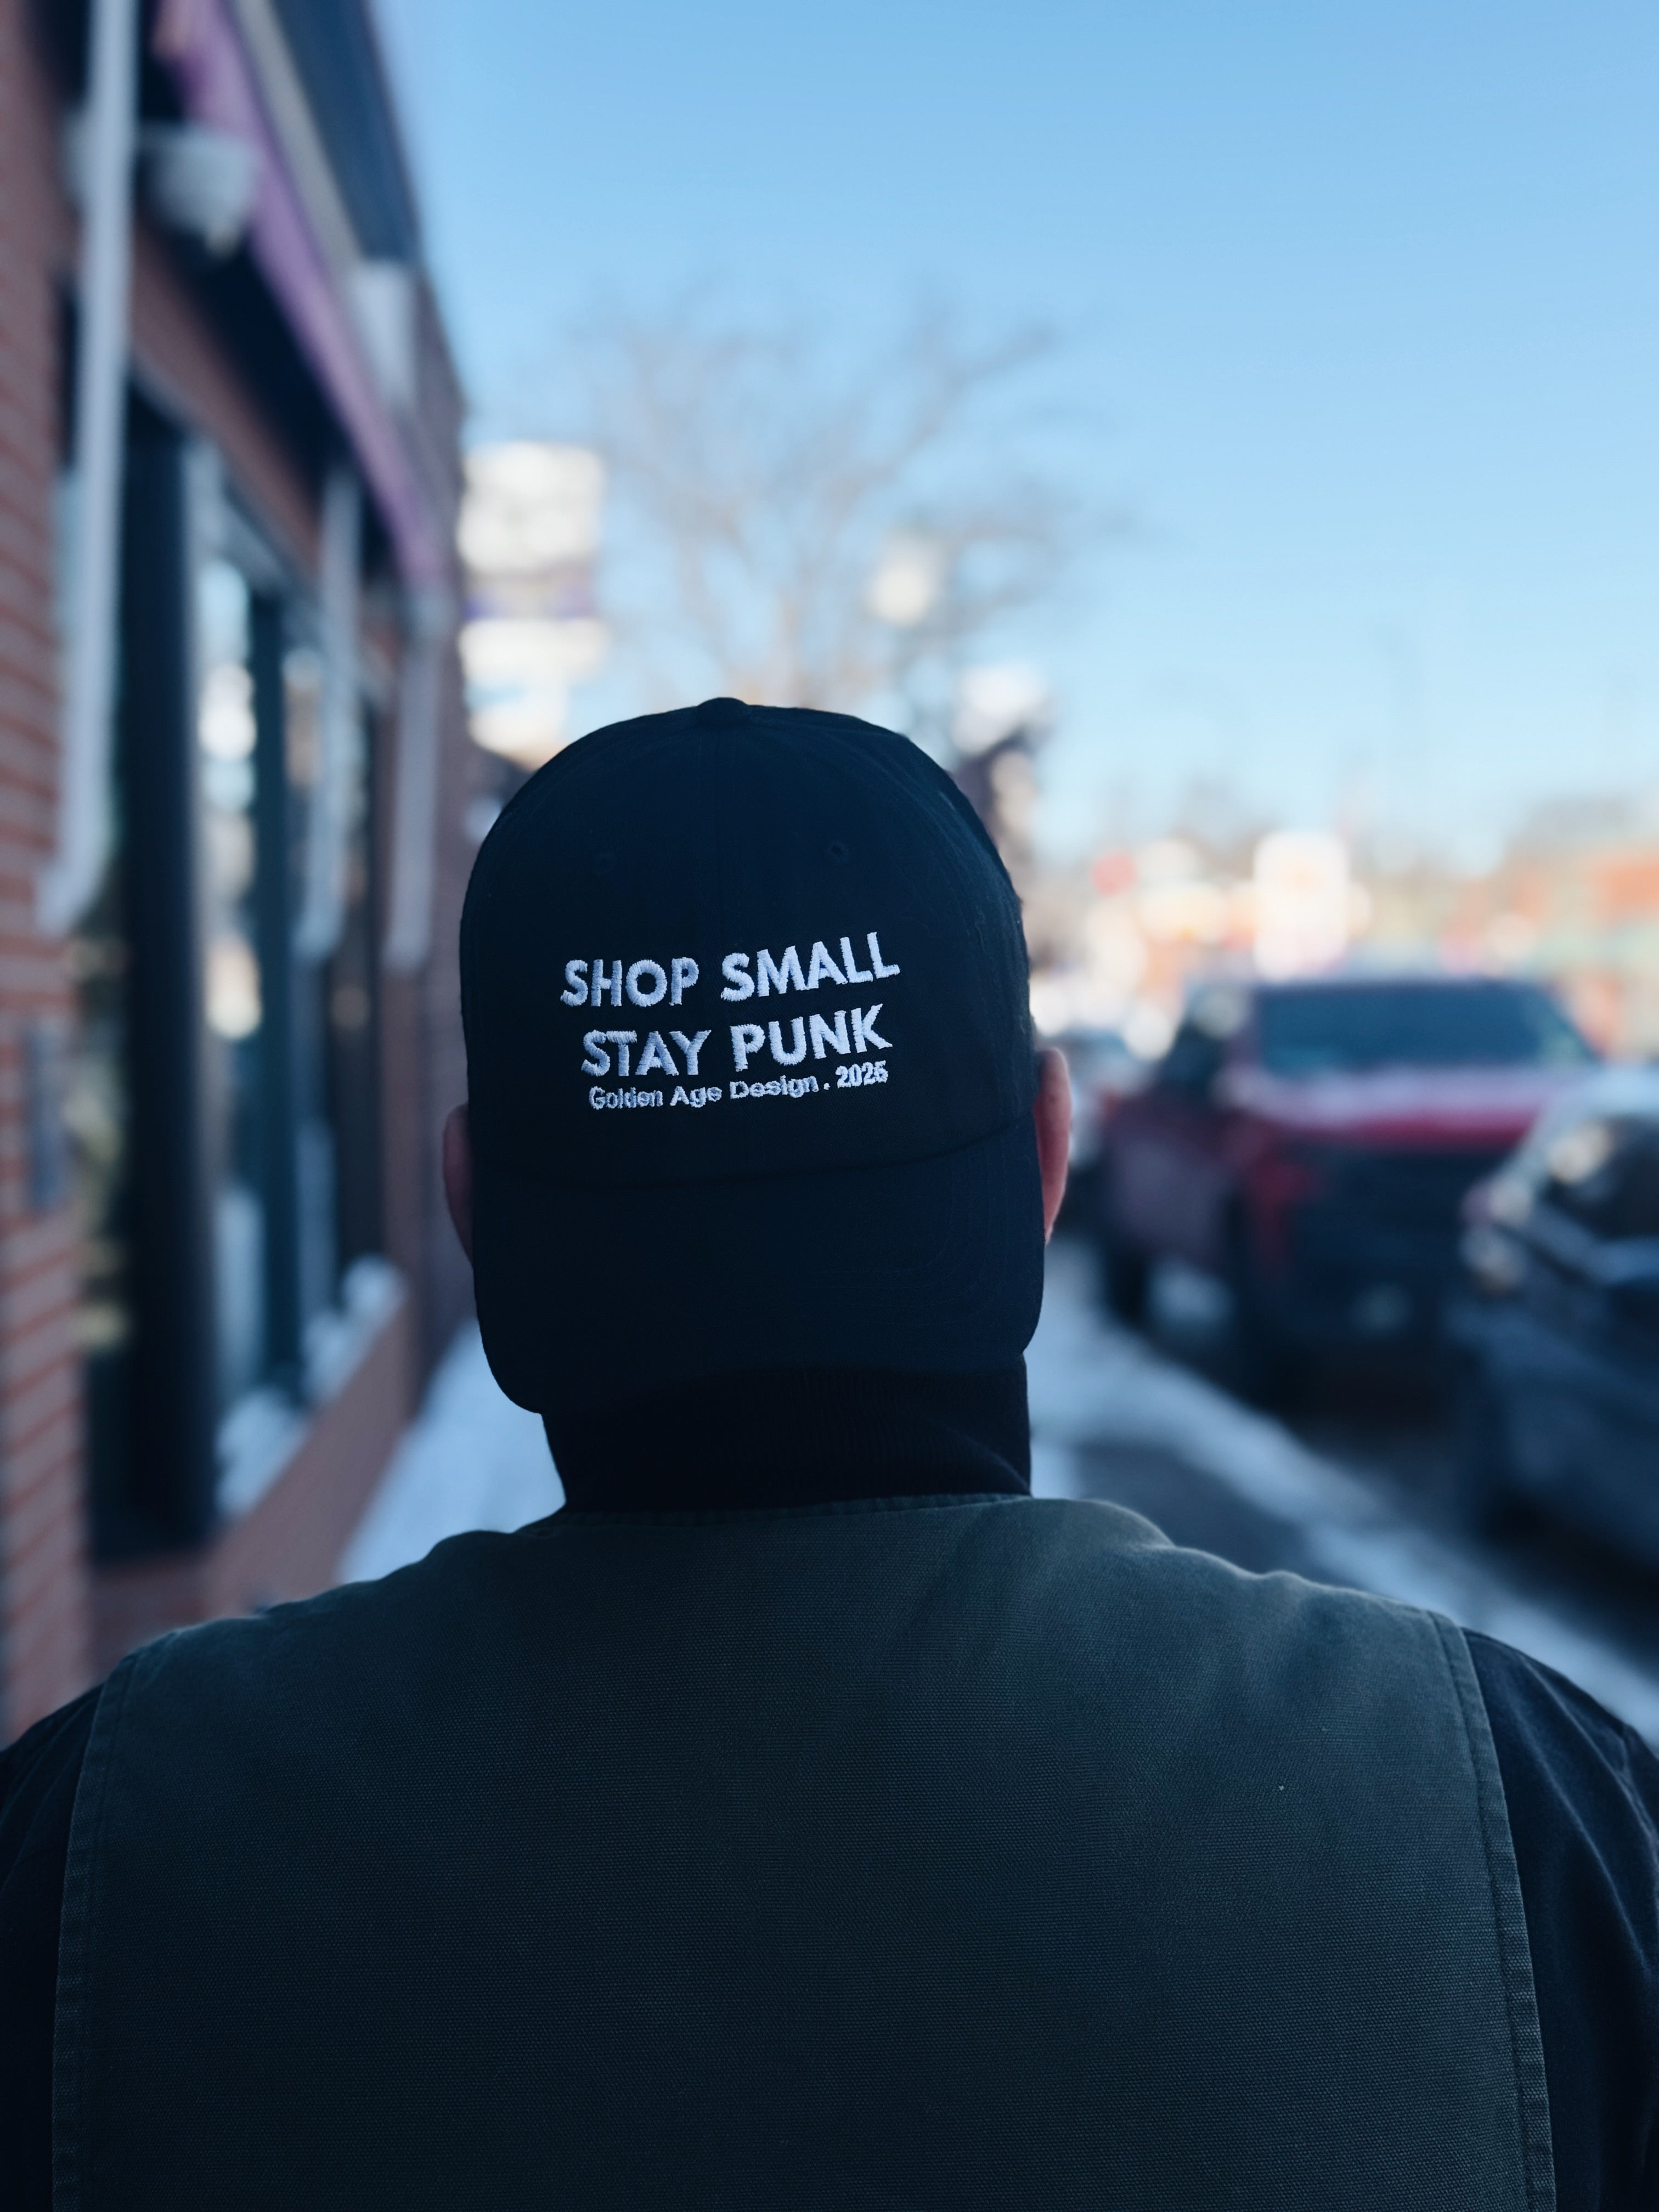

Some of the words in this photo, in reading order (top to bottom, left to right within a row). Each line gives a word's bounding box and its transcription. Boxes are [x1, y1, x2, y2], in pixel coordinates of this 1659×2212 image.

[560, 957, 699, 1007] SHOP
[720, 932, 900, 1002] SMALL
[581, 1029, 712, 1076] STAY
[730, 1003, 893, 1072] PUNK
[589, 1086, 664, 1110] Golden
[669, 1086, 723, 1108] Age
[835, 1059, 889, 1089] 2025
